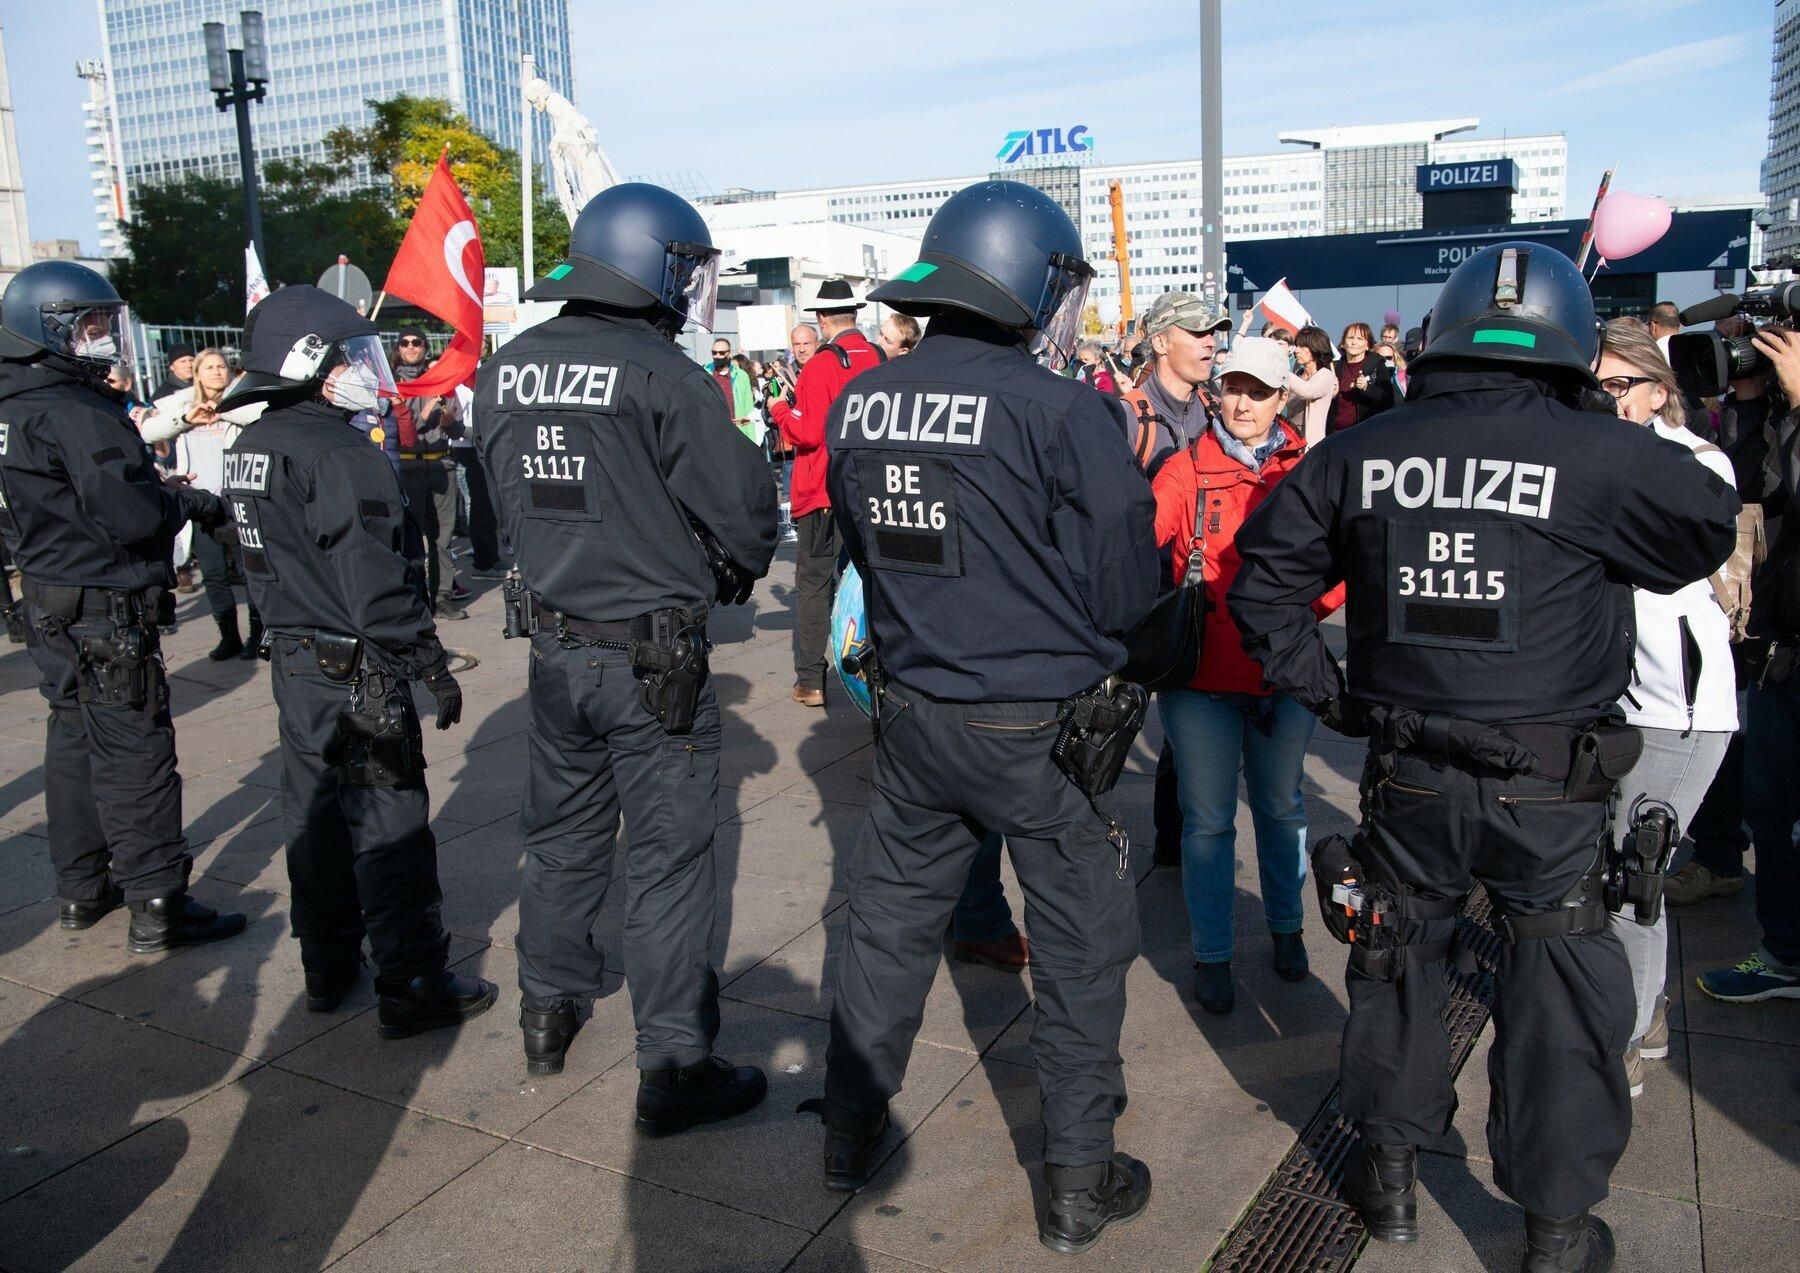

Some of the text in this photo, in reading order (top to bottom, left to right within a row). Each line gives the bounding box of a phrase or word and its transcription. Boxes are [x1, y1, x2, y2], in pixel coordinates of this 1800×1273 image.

[1430, 165, 1498, 186] POLIZEI
[1424, 266, 1448, 275] Wache
[497, 363, 618, 406] POLIZEI
[840, 391, 988, 445] POLIZEI
[536, 425, 566, 451] BE
[224, 452, 270, 491] POLIZEI
[521, 454, 586, 481] 31117
[885, 464, 921, 495] BE
[1361, 456, 1557, 520] POLIZEI
[233, 502, 249, 524] BE
[868, 496, 947, 531] 31116
[1428, 531, 1476, 564] BE
[1399, 566, 1506, 601] 31115
